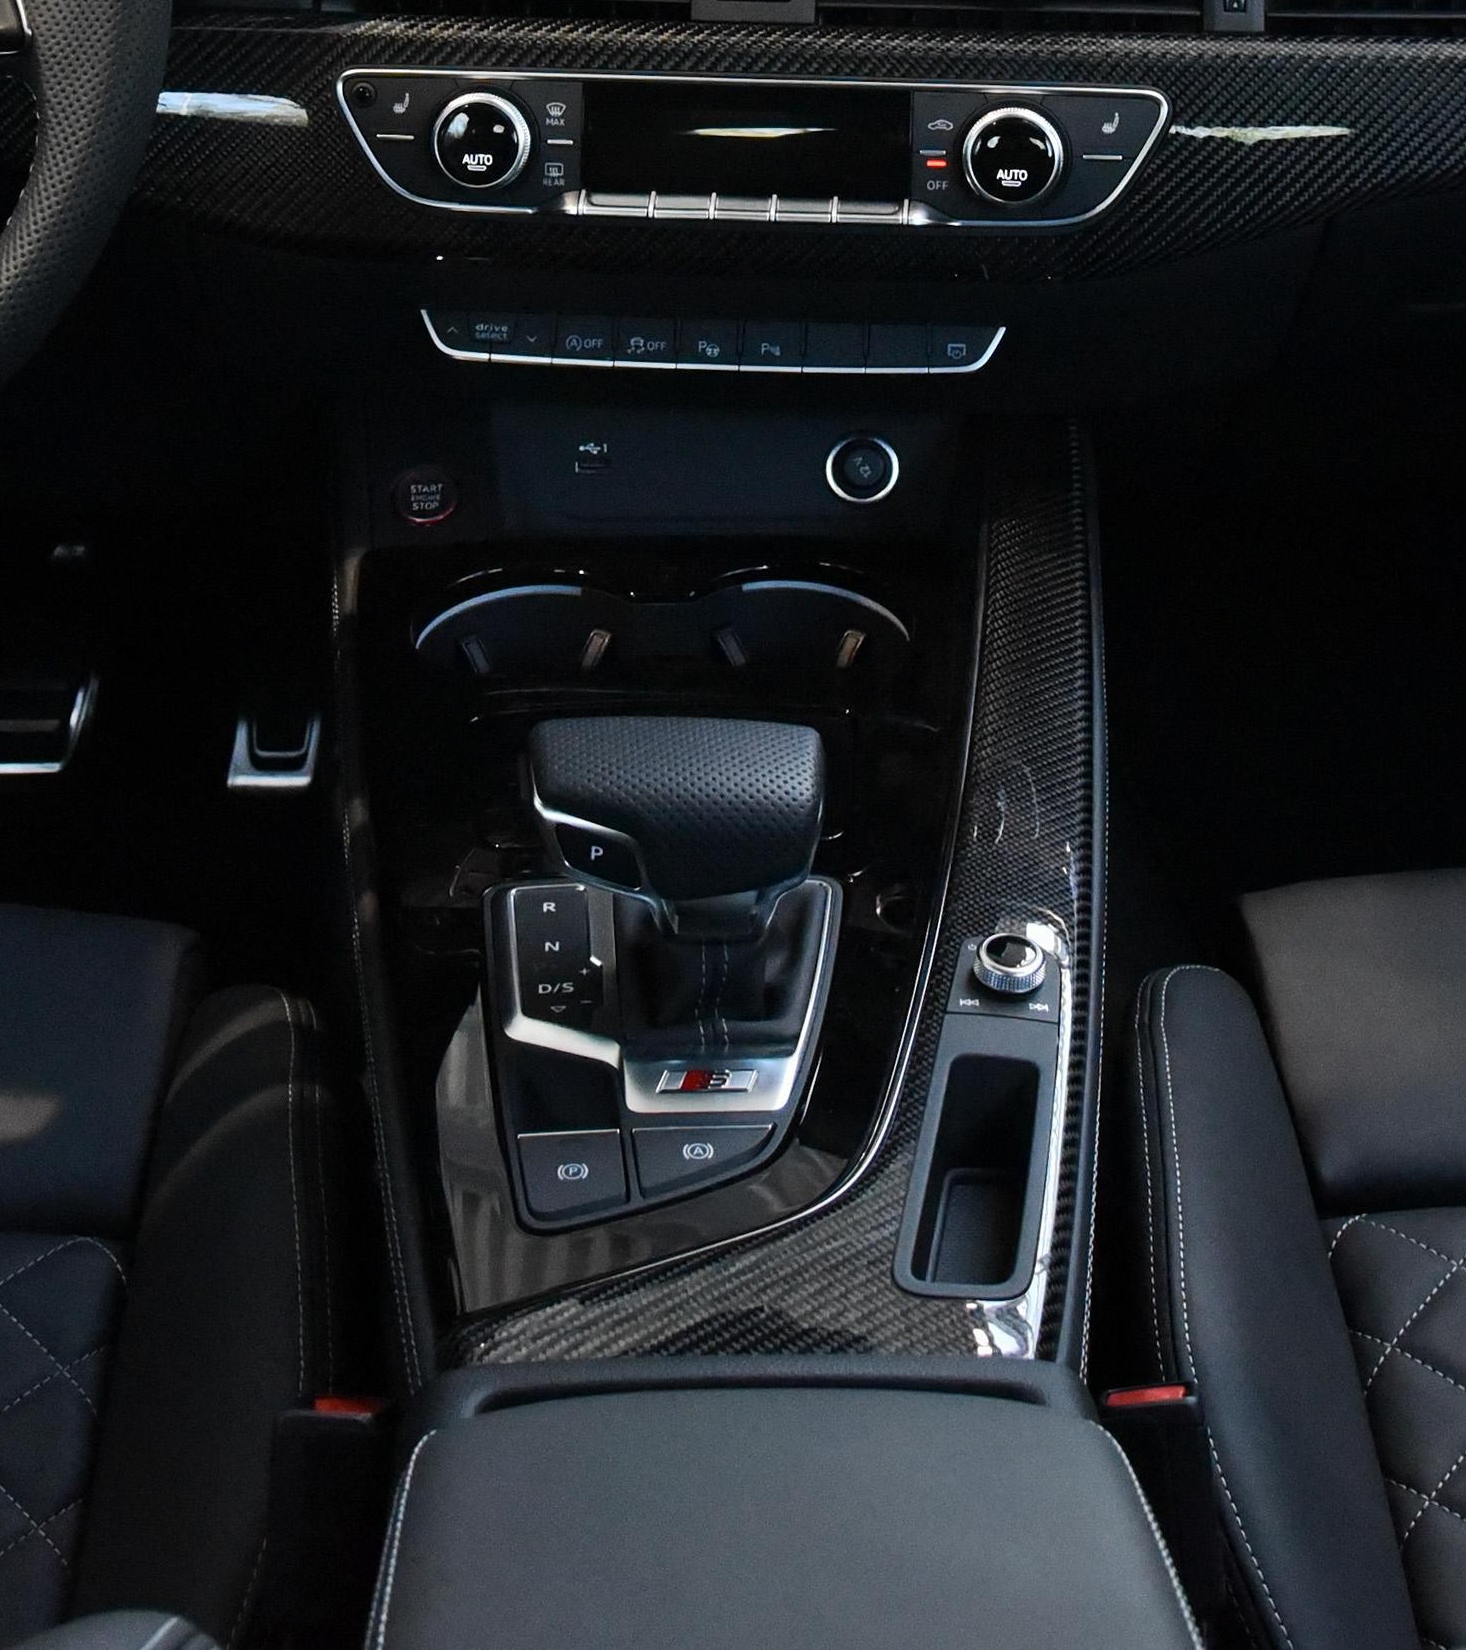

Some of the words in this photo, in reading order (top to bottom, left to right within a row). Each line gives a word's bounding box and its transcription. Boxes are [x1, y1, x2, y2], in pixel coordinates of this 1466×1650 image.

[545, 117, 566, 127] MAX
[462, 153, 494, 166] AUTO
[996, 168, 1029, 182] AUTO
[542, 177, 566, 187] REAR
[926, 179, 950, 191] OFF
[474, 323, 509, 333] drive
[583, 338, 604, 349] OFF
[646, 340, 667, 351] OFF
[409, 483, 444, 494] START
[412, 501, 439, 511] STOP
[590, 845, 604, 861] P
[542, 901, 556, 913] R
[544, 941, 560, 952] N
[537, 982, 575, 995] D/S
